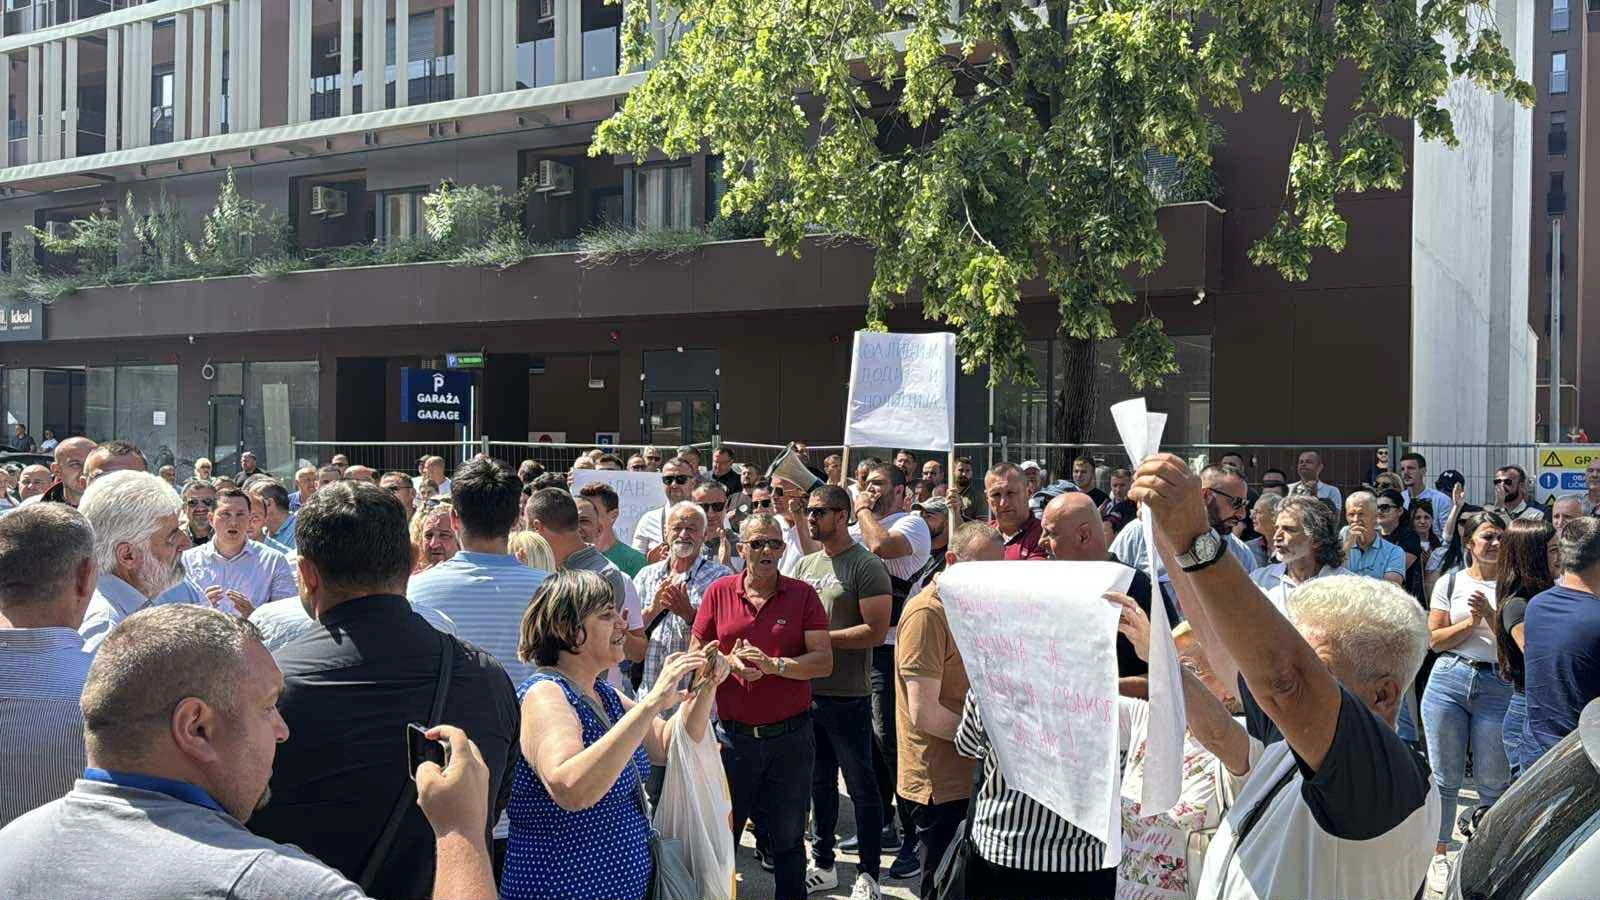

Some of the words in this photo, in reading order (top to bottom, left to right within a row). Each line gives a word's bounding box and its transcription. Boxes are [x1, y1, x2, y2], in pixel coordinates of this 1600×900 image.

[11, 309, 33, 323] ideal
[416, 392, 461, 405] GARAŽA
[416, 409, 460, 421] GARAGE
